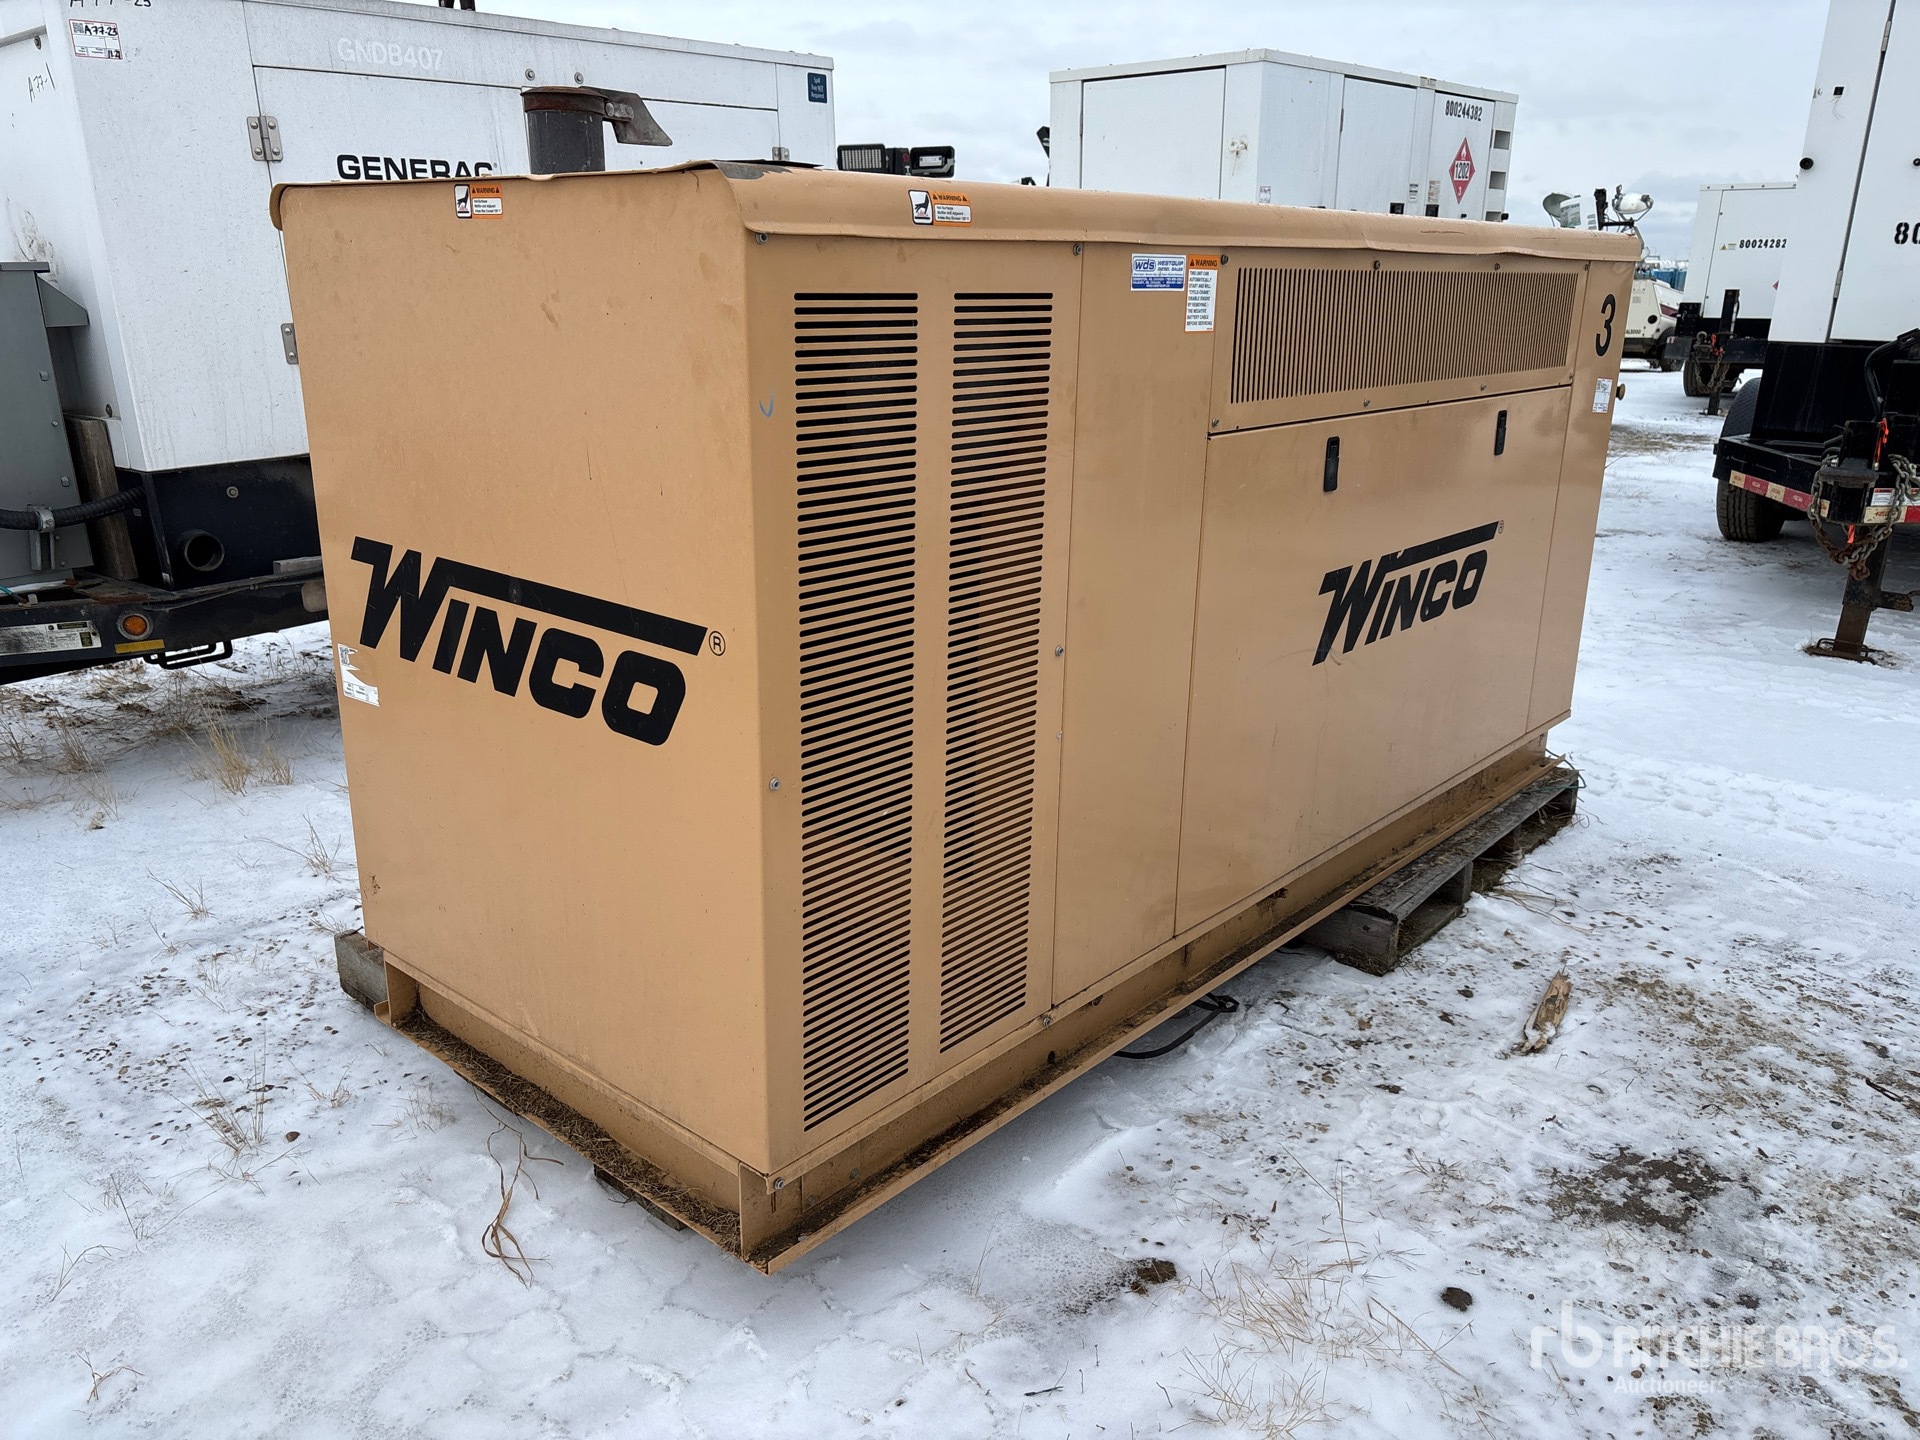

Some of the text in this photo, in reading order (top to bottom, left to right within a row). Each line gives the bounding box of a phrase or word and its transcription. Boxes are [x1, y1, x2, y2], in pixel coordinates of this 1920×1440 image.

[337, 37, 443, 70] GNDB407
[1445, 100, 1482, 122] 800244382
[1455, 162, 1470, 180] 1202
[1596, 294, 1616, 356] 3
[1312, 521, 1499, 666] WINCO
[351, 536, 708, 746] WINCO
